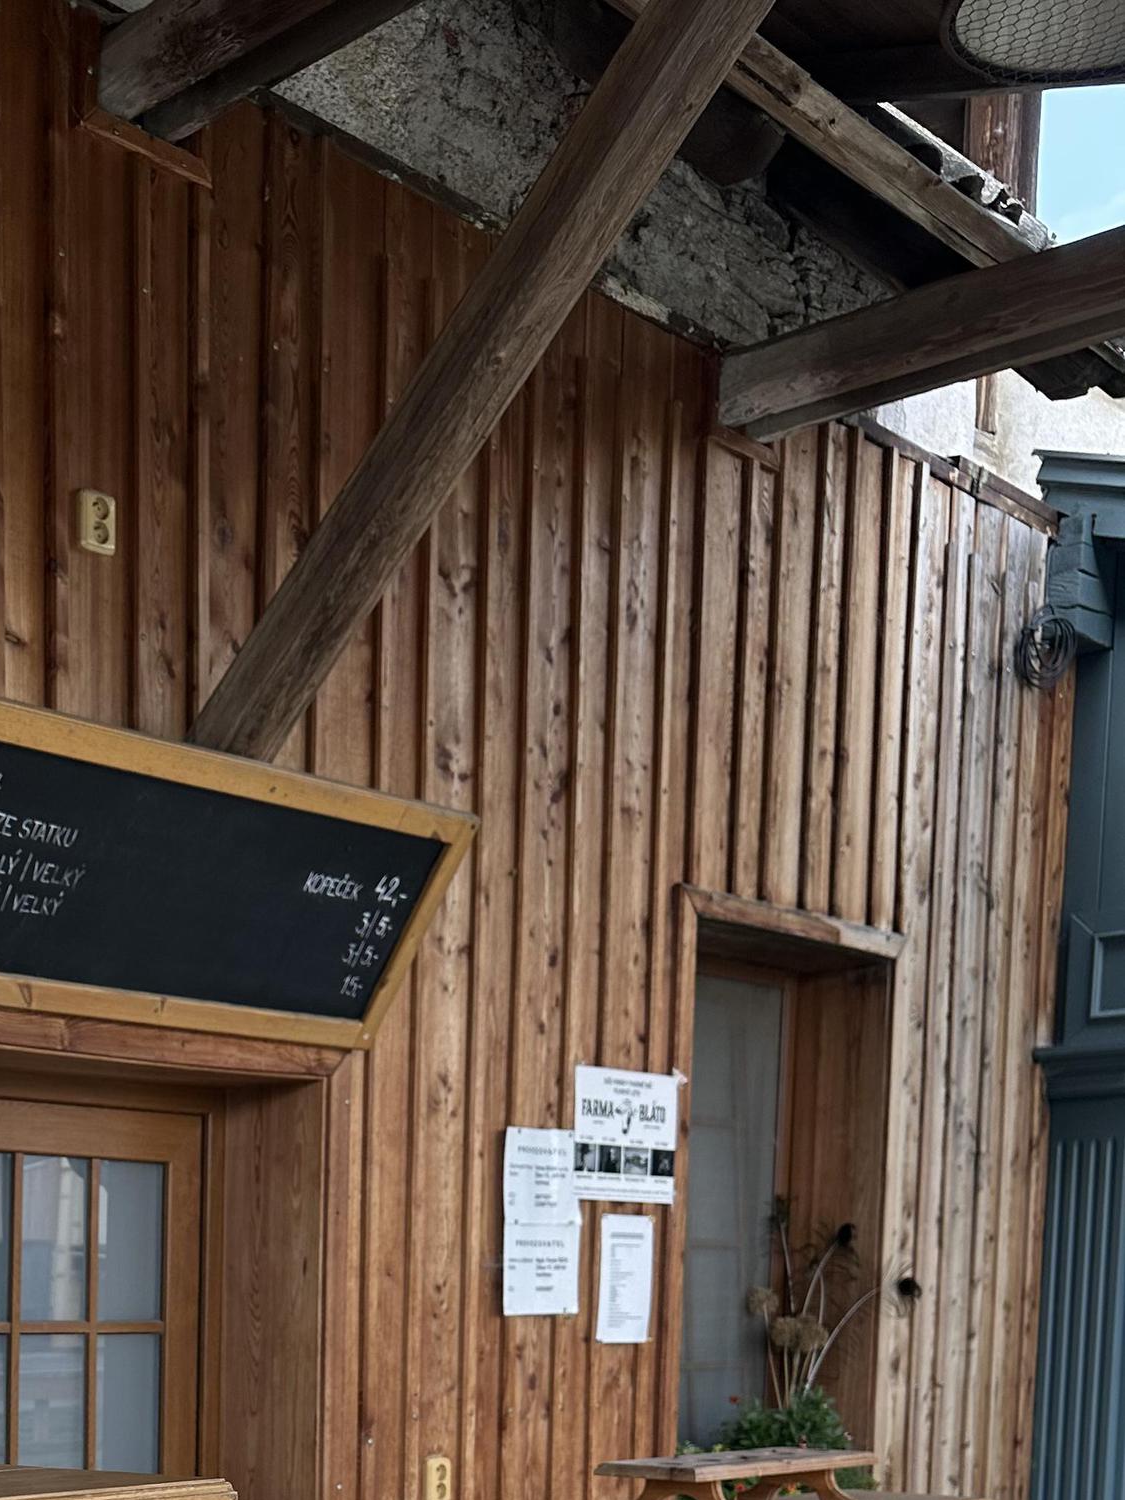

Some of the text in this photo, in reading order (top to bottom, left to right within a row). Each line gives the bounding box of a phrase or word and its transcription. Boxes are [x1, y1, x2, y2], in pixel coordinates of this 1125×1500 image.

[20, 819, 80, 848] STATKU
[581, 1098, 666, 1124] FARMA BLÁTO
